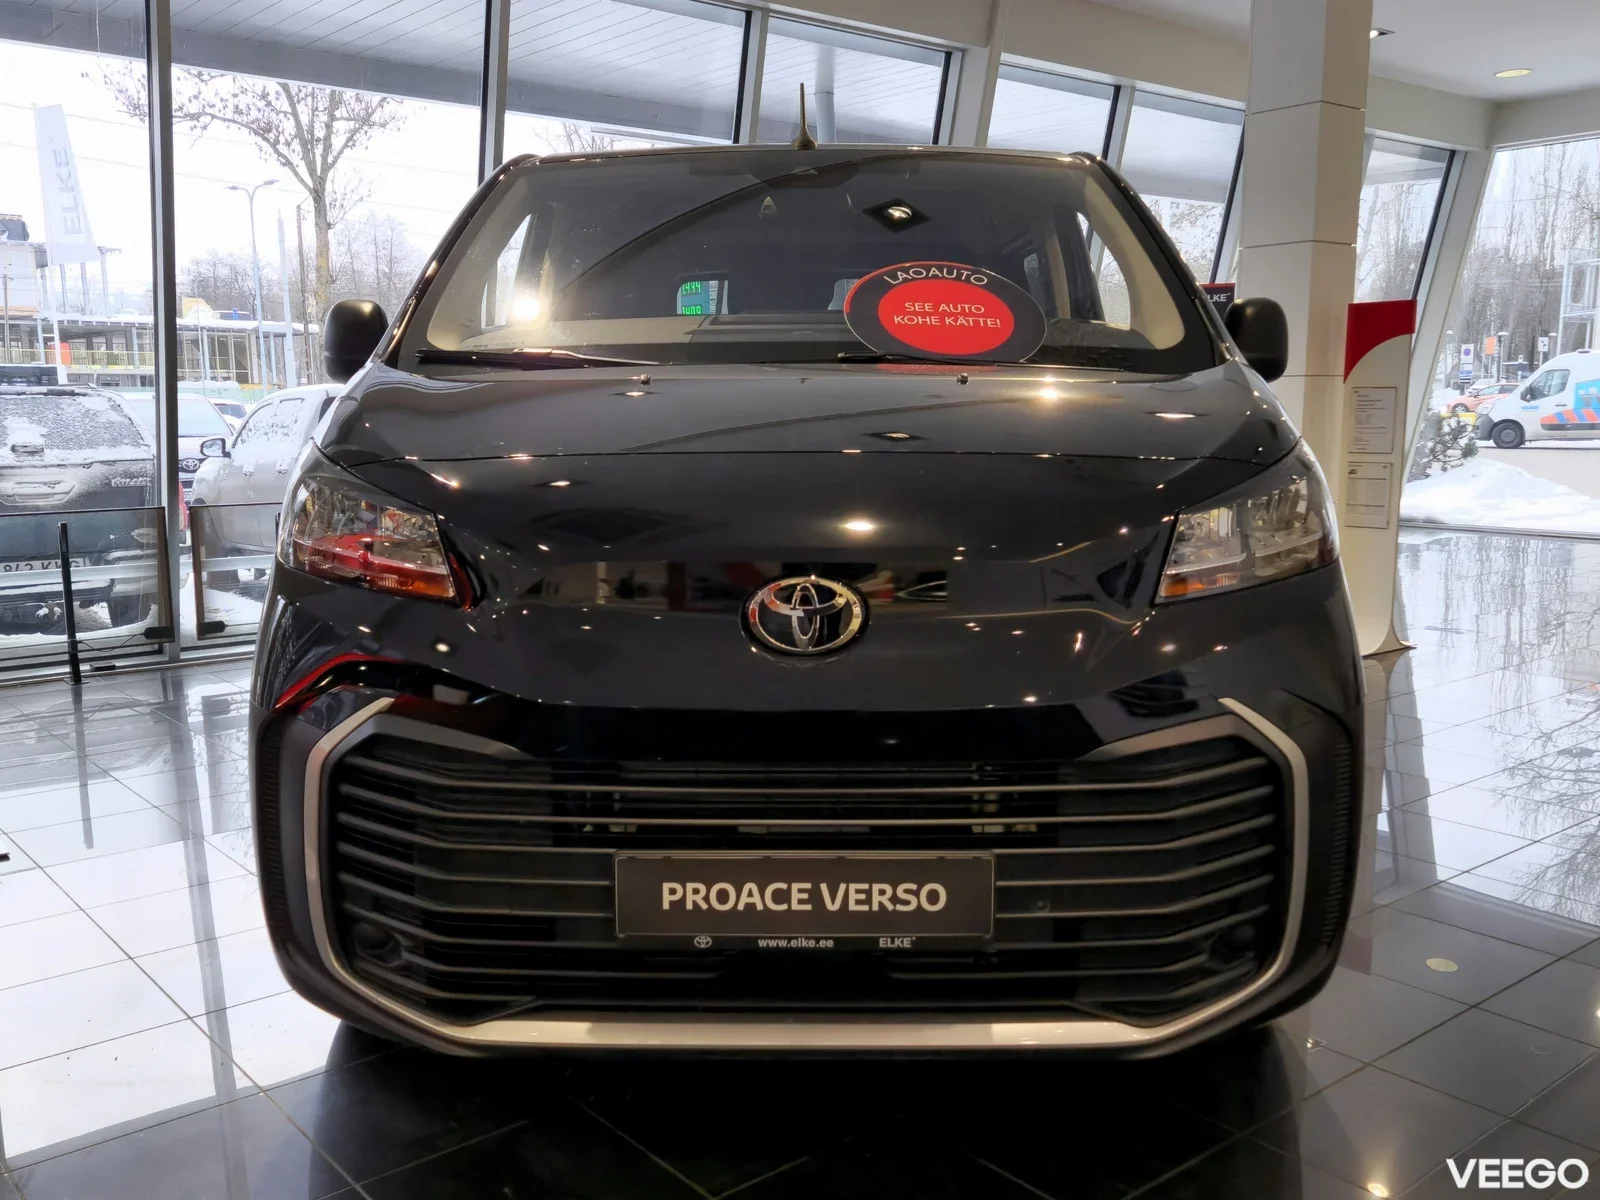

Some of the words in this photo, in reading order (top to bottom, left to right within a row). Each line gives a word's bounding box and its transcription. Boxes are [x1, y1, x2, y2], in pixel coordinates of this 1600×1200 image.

[53, 149, 83, 234] ELKE
[883, 267, 988, 285] LAOAUTO
[1205, 294, 1227, 302] LKE
[904, 302, 934, 312] SEE
[938, 303, 985, 314] AUTO
[893, 315, 941, 326] KOHE
[945, 315, 1002, 328] KÄTTE!
[662, 882, 812, 911] PROACE
[820, 882, 947, 912] VERSO
[758, 937, 834, 948] www.elke.ee
[879, 937, 911, 948] ELKE
